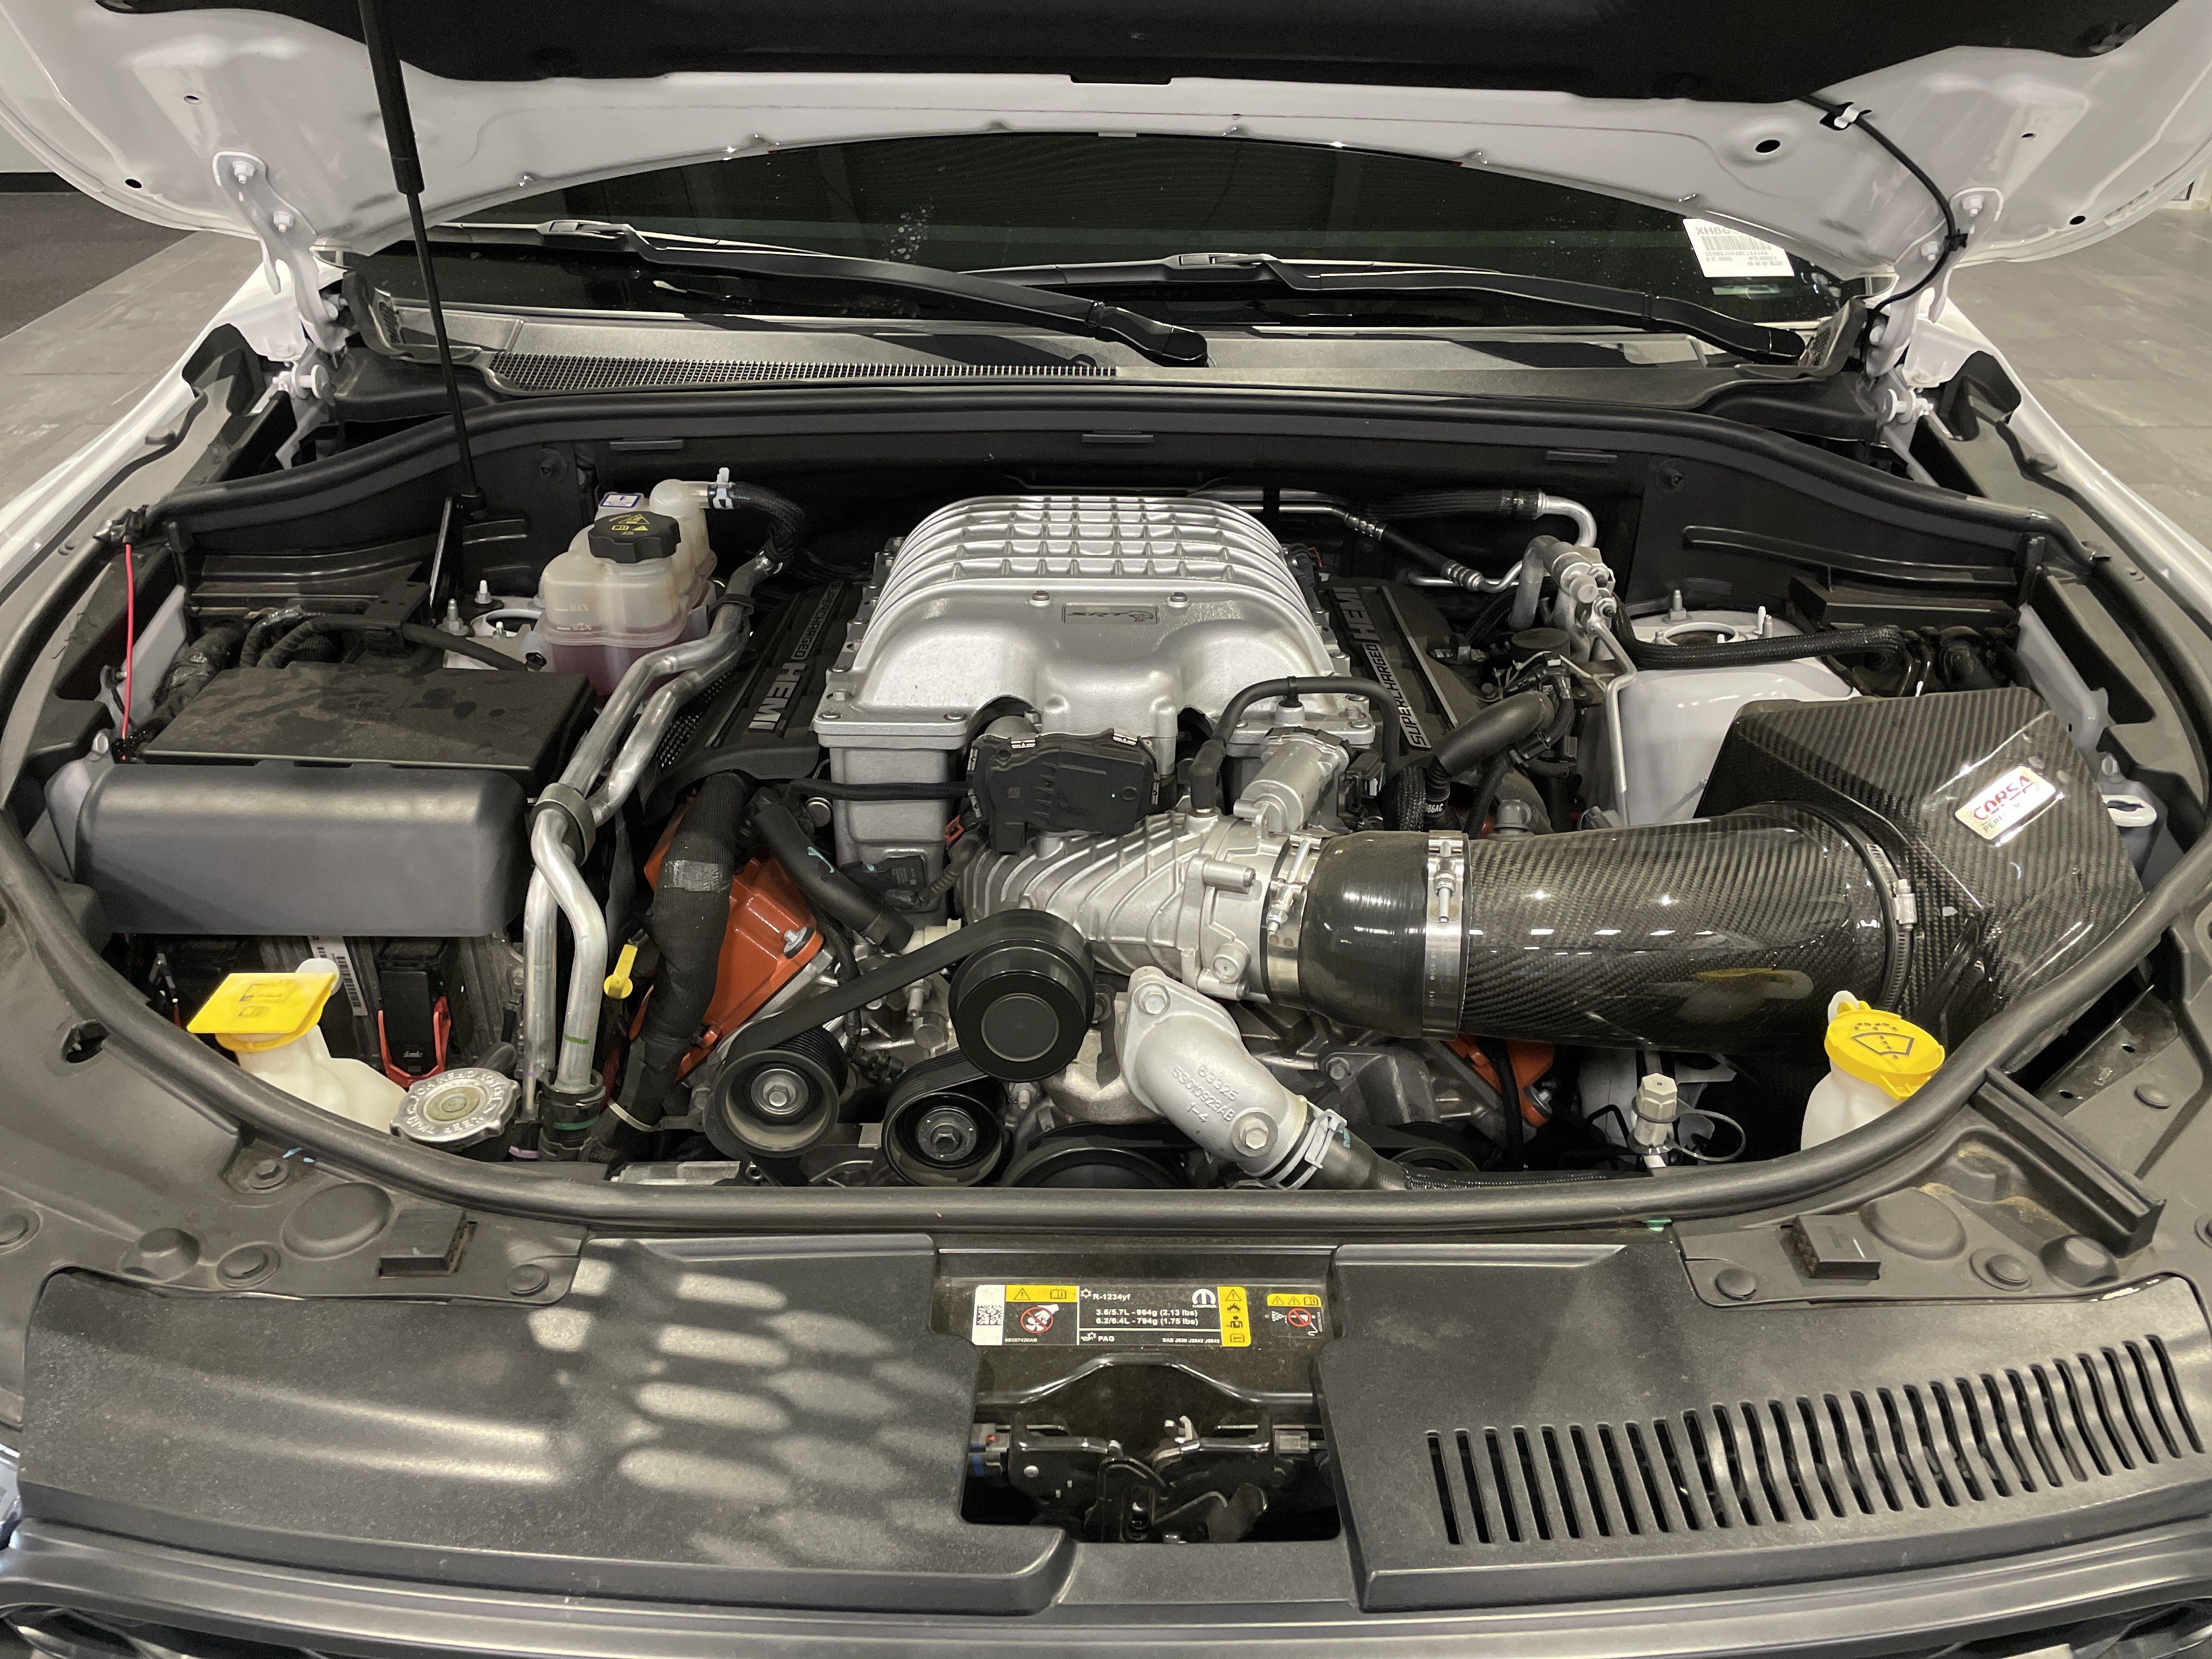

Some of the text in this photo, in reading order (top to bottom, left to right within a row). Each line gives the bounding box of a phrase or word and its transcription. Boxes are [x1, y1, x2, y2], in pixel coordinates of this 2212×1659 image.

[1333, 588, 1381, 641] HEMI
[748, 662, 808, 731] HEMI
[1093, 1293, 1131, 1301] R-1234yf
